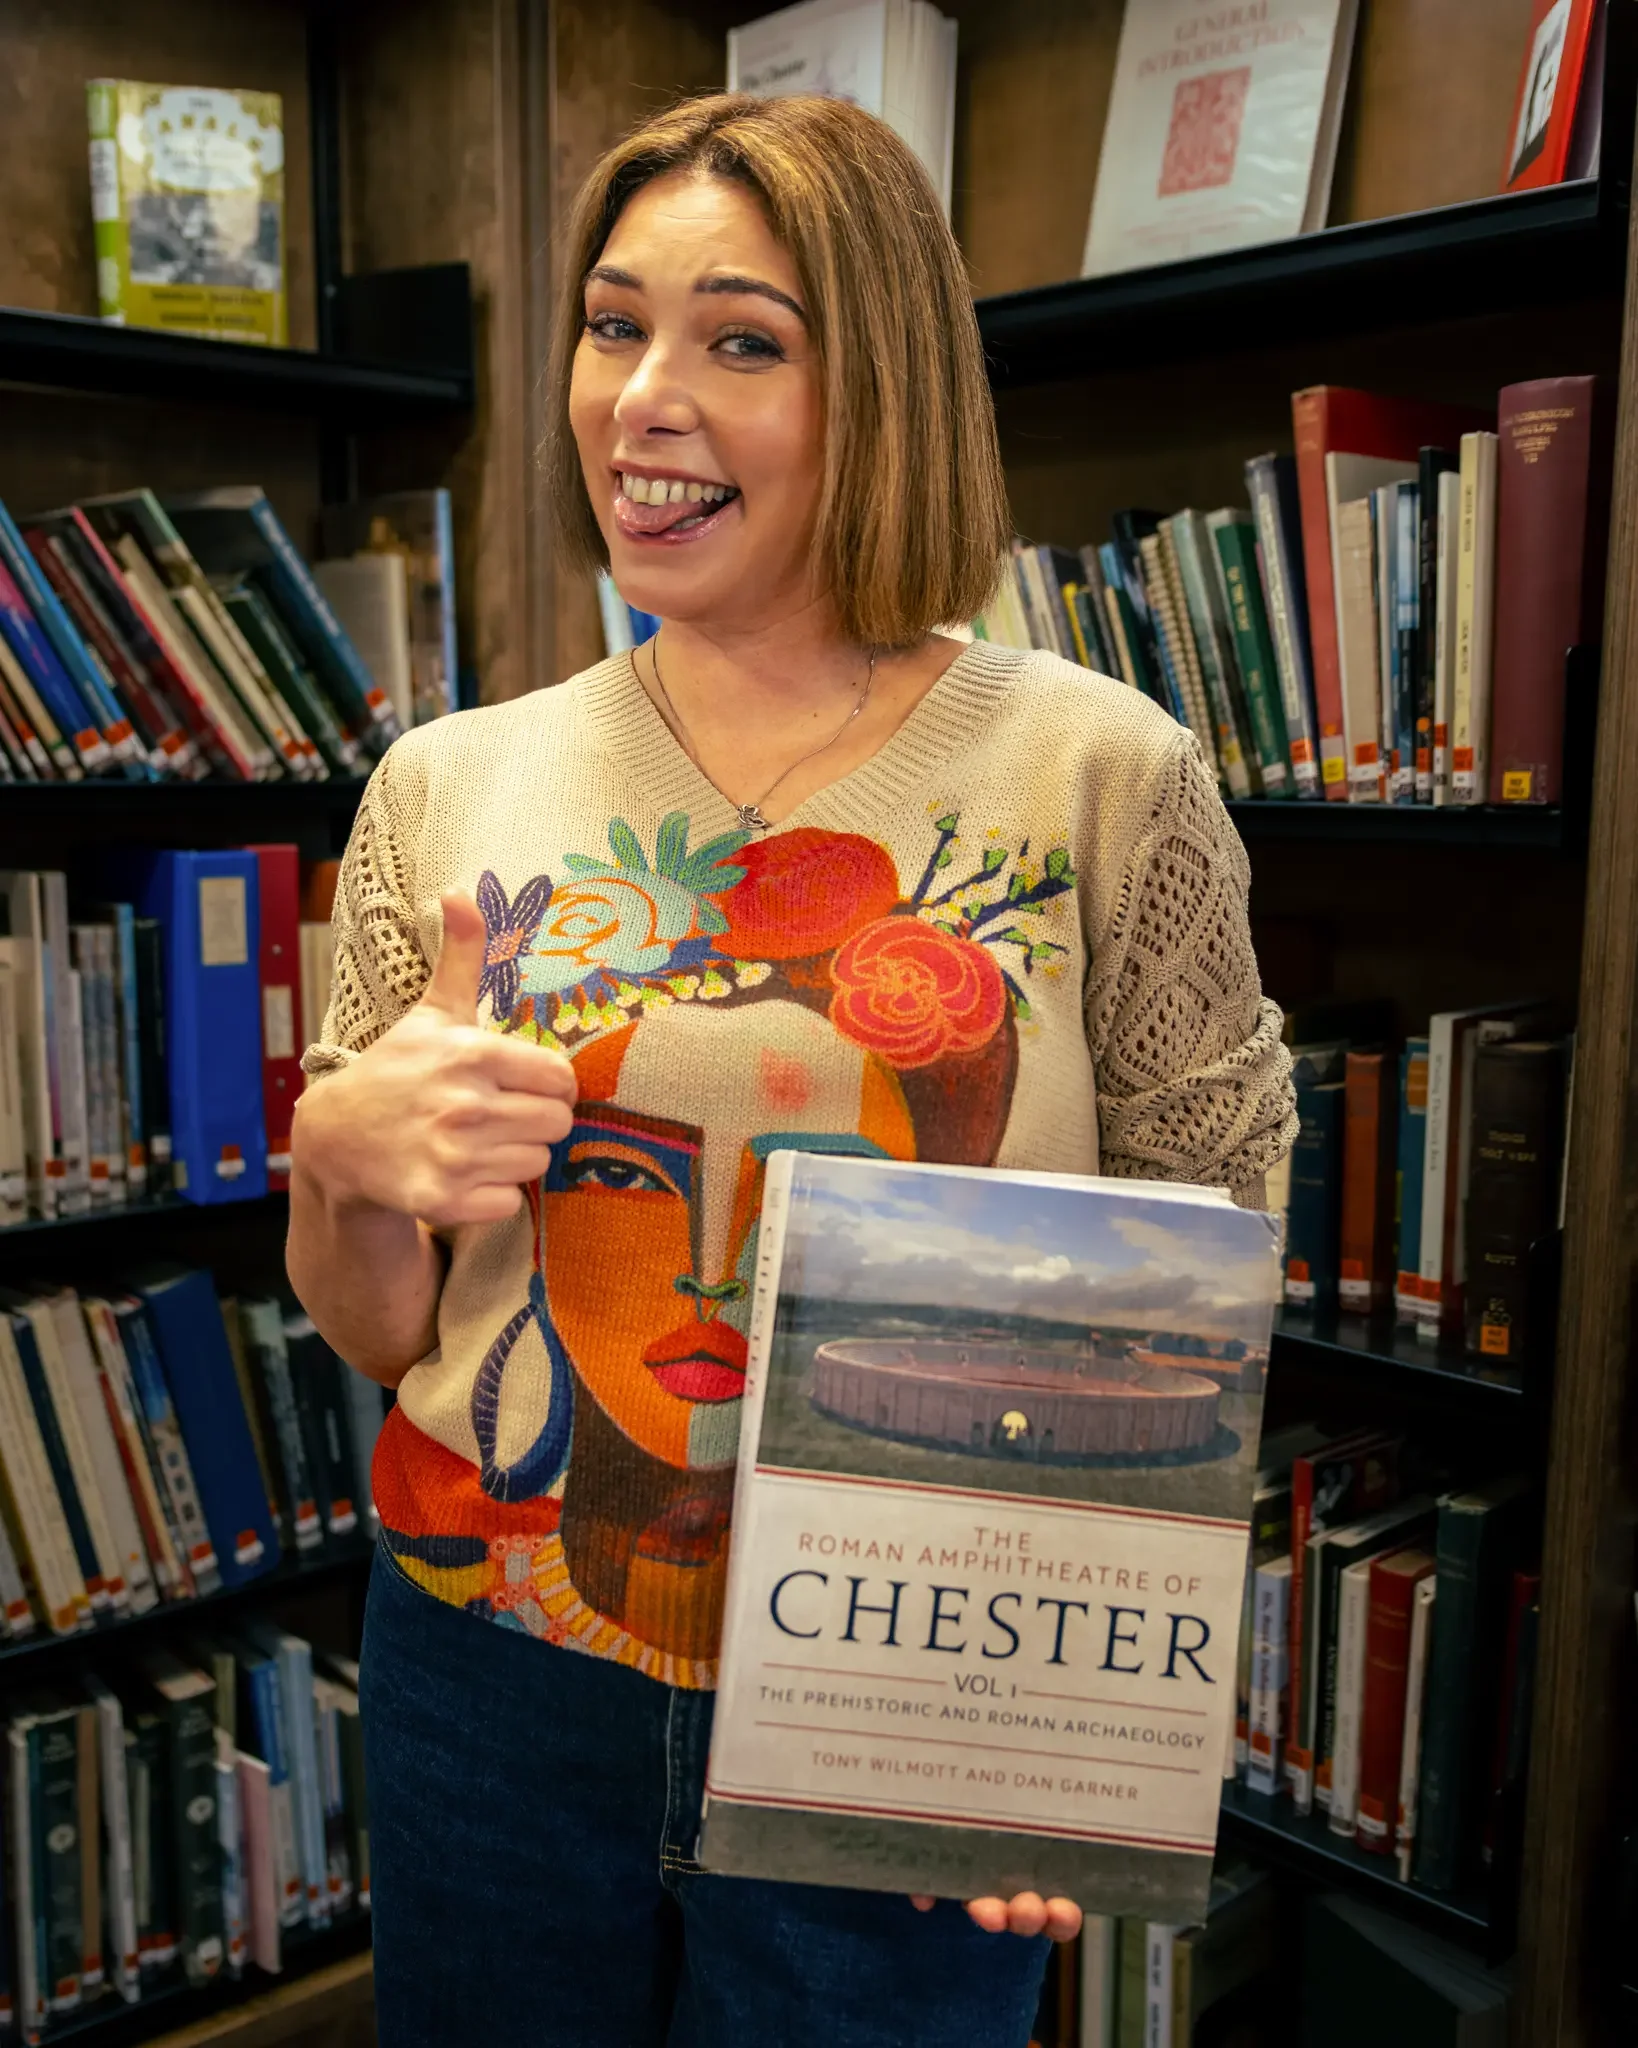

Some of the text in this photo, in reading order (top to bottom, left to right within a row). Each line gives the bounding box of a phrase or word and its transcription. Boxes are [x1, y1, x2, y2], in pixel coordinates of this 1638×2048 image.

[798, 1532, 1202, 1597] ROMAN AMPHITHEATRE OF
[974, 1526, 1031, 1552] THE
[768, 1568, 1217, 1685] CHESTER
[953, 1672, 1003, 1698] VOL
[759, 1685, 1206, 1749] THE PREHISTORIC AND ROMAN ARCHAEOLOGY
[812, 1751, 1139, 1801] TONY WILMOTT AND DAN GARNER
